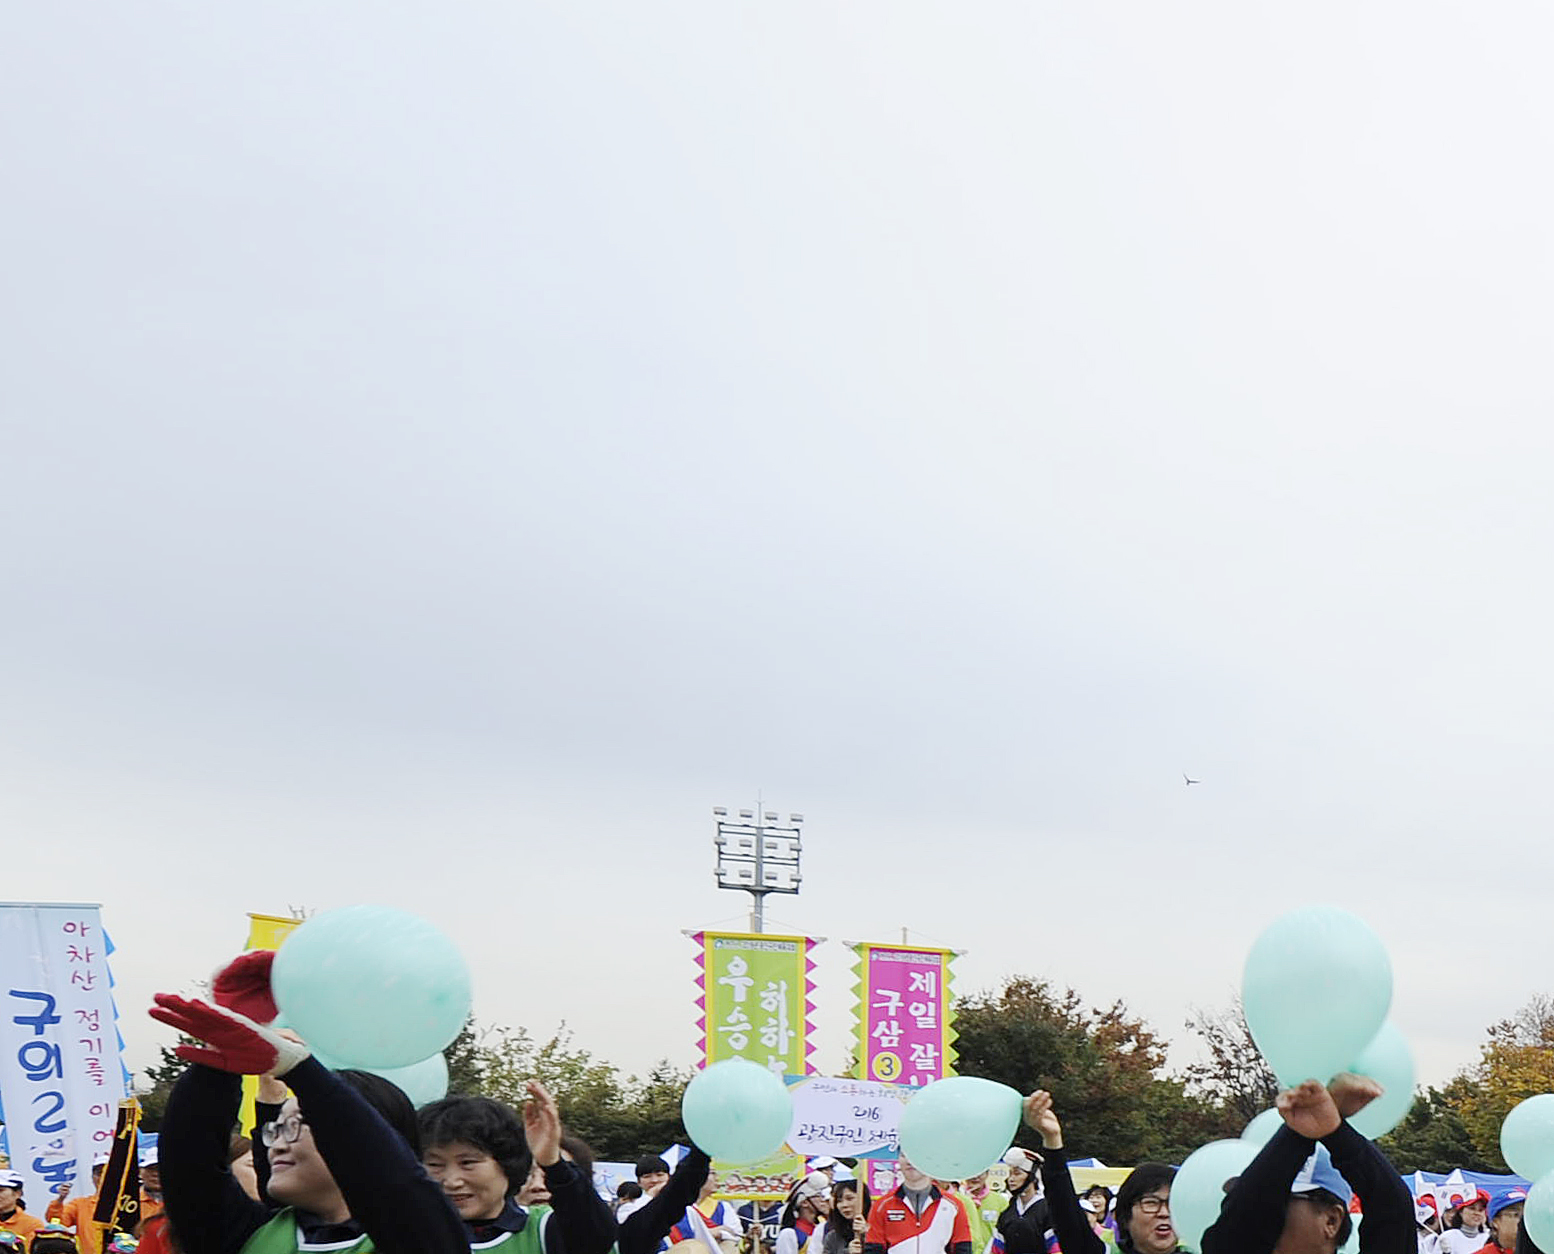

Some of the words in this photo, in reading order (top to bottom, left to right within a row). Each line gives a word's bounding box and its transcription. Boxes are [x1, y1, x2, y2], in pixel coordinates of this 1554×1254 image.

[62, 920, 97, 991] 아차산
[717, 955, 754, 1060] 우승
[871, 988, 905, 1048] 구삼
[908, 970, 938, 1029] 제일
[73, 1009, 105, 1087] 정기를
[88, 1102, 115, 1158] 이어
[797, 1123, 863, 1144] 광진구민
[852, 1105, 880, 1120] 2016
